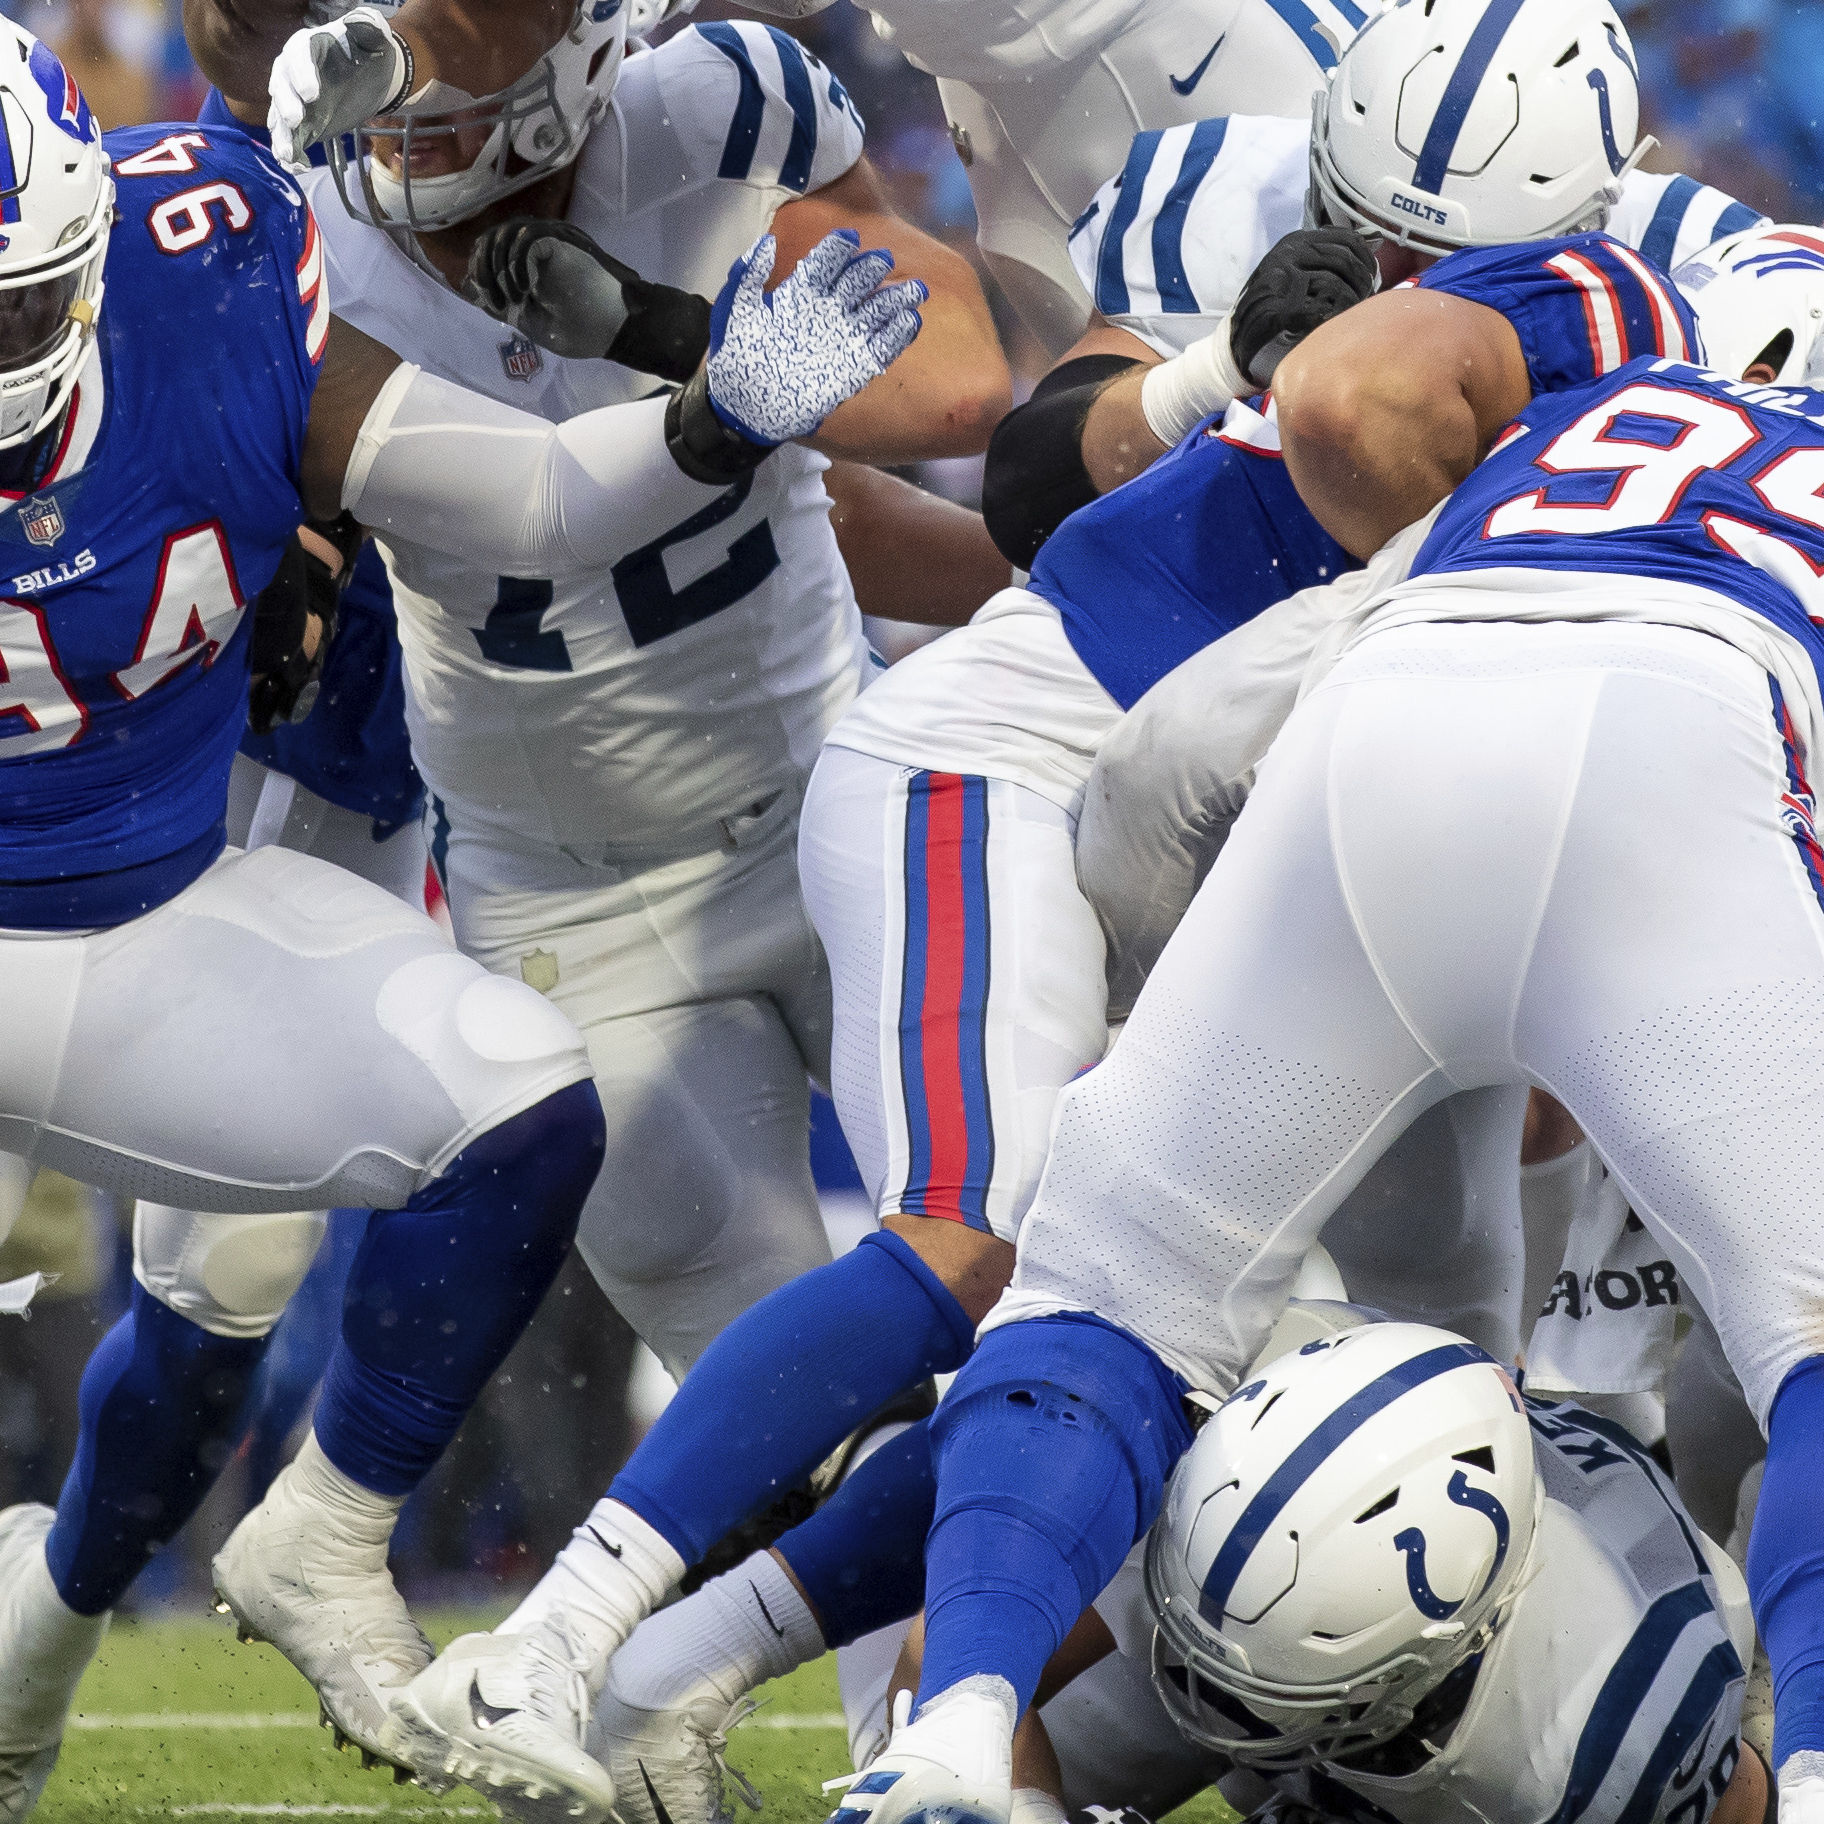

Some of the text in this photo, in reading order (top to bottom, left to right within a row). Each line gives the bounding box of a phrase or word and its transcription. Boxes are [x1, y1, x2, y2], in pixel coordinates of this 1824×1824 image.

[111, 132, 255, 256] 94
[1390, 192, 1448, 226] COLTS
[29, 516, 59, 538] NFL
[12, 547, 97, 594] BILLS
